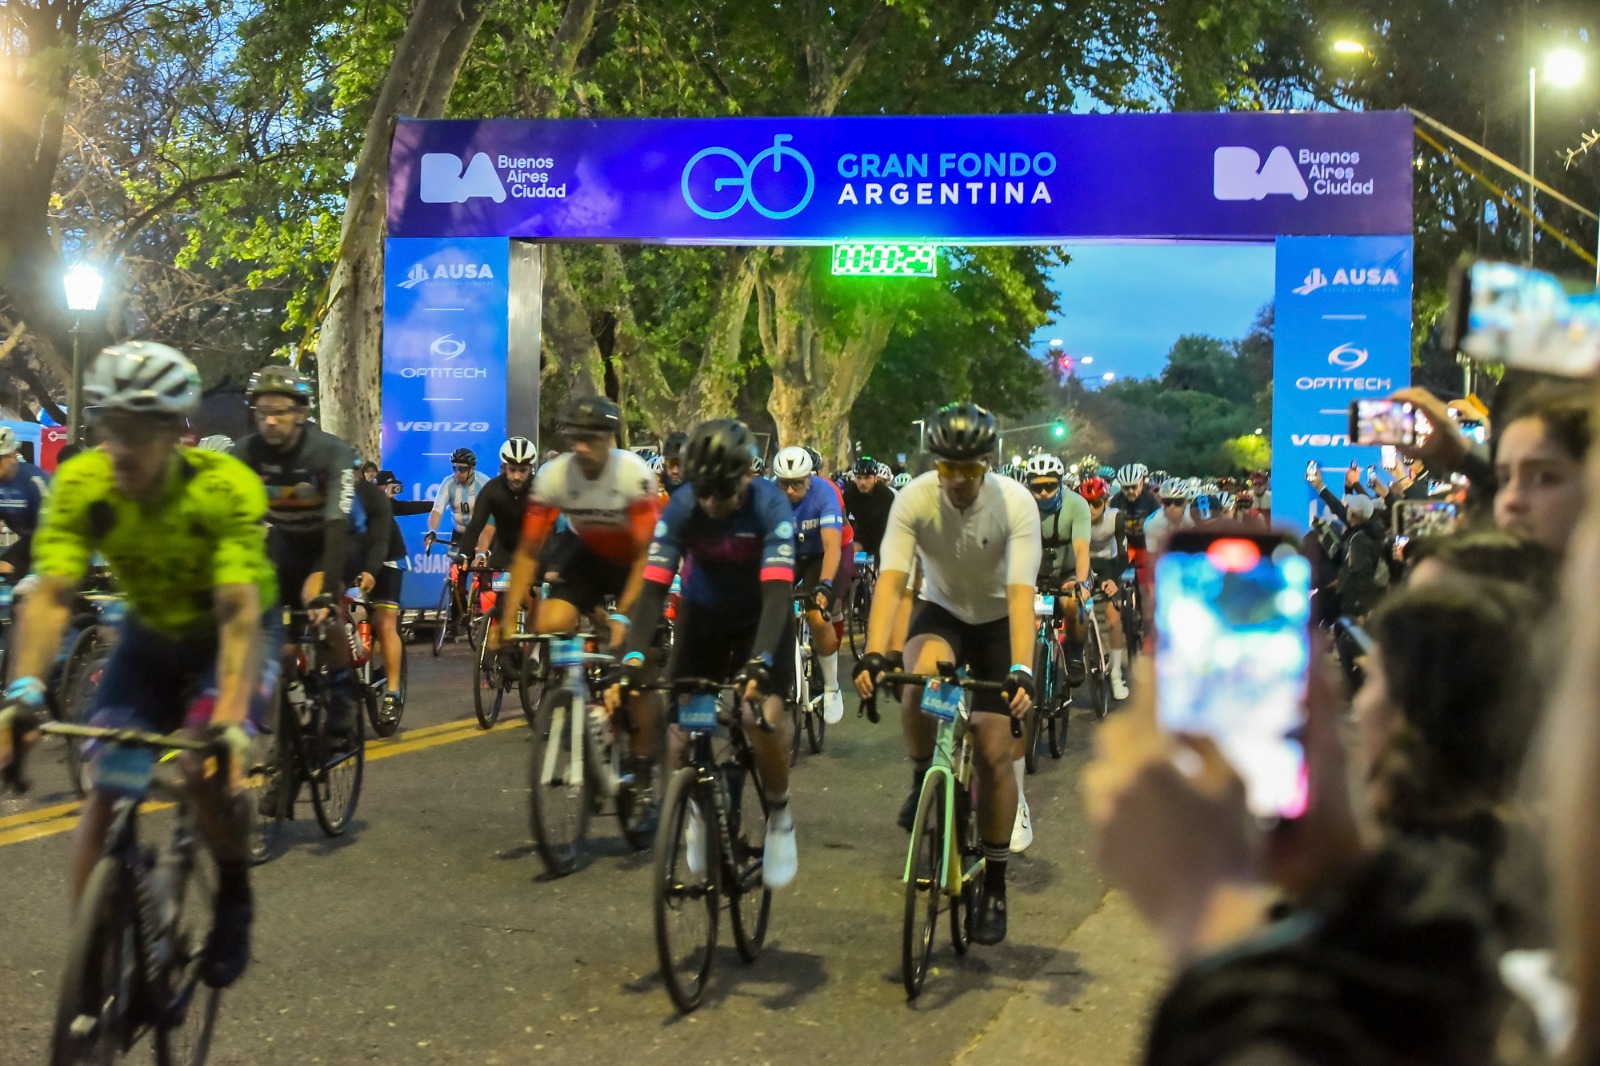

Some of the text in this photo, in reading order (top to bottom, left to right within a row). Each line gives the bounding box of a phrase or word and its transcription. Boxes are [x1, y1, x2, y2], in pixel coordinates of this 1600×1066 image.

[498, 155, 554, 168] Buenos
[1299, 149, 1360, 164] Buenos
[837, 151, 1057, 178] GRAN FONDO
[1309, 165, 1355, 179] Aires
[420, 152, 507, 203] BA
[506, 170, 548, 183] Aires
[1213, 145, 1309, 201] BA
[511, 183, 566, 198] Ciudad
[837, 181, 1052, 205] ARGENTINA
[1314, 178, 1374, 195] Ciudad
[834, 245, 935, 274] 00:00:29
[433, 264, 494, 279] AUSA
[1332, 268, 1399, 286] AUSA
[400, 367, 486, 379] OPTITECH
[1295, 377, 1391, 390] OPTITECH
[1290, 434, 1351, 446] ven
[414, 553, 453, 574] SUAR
